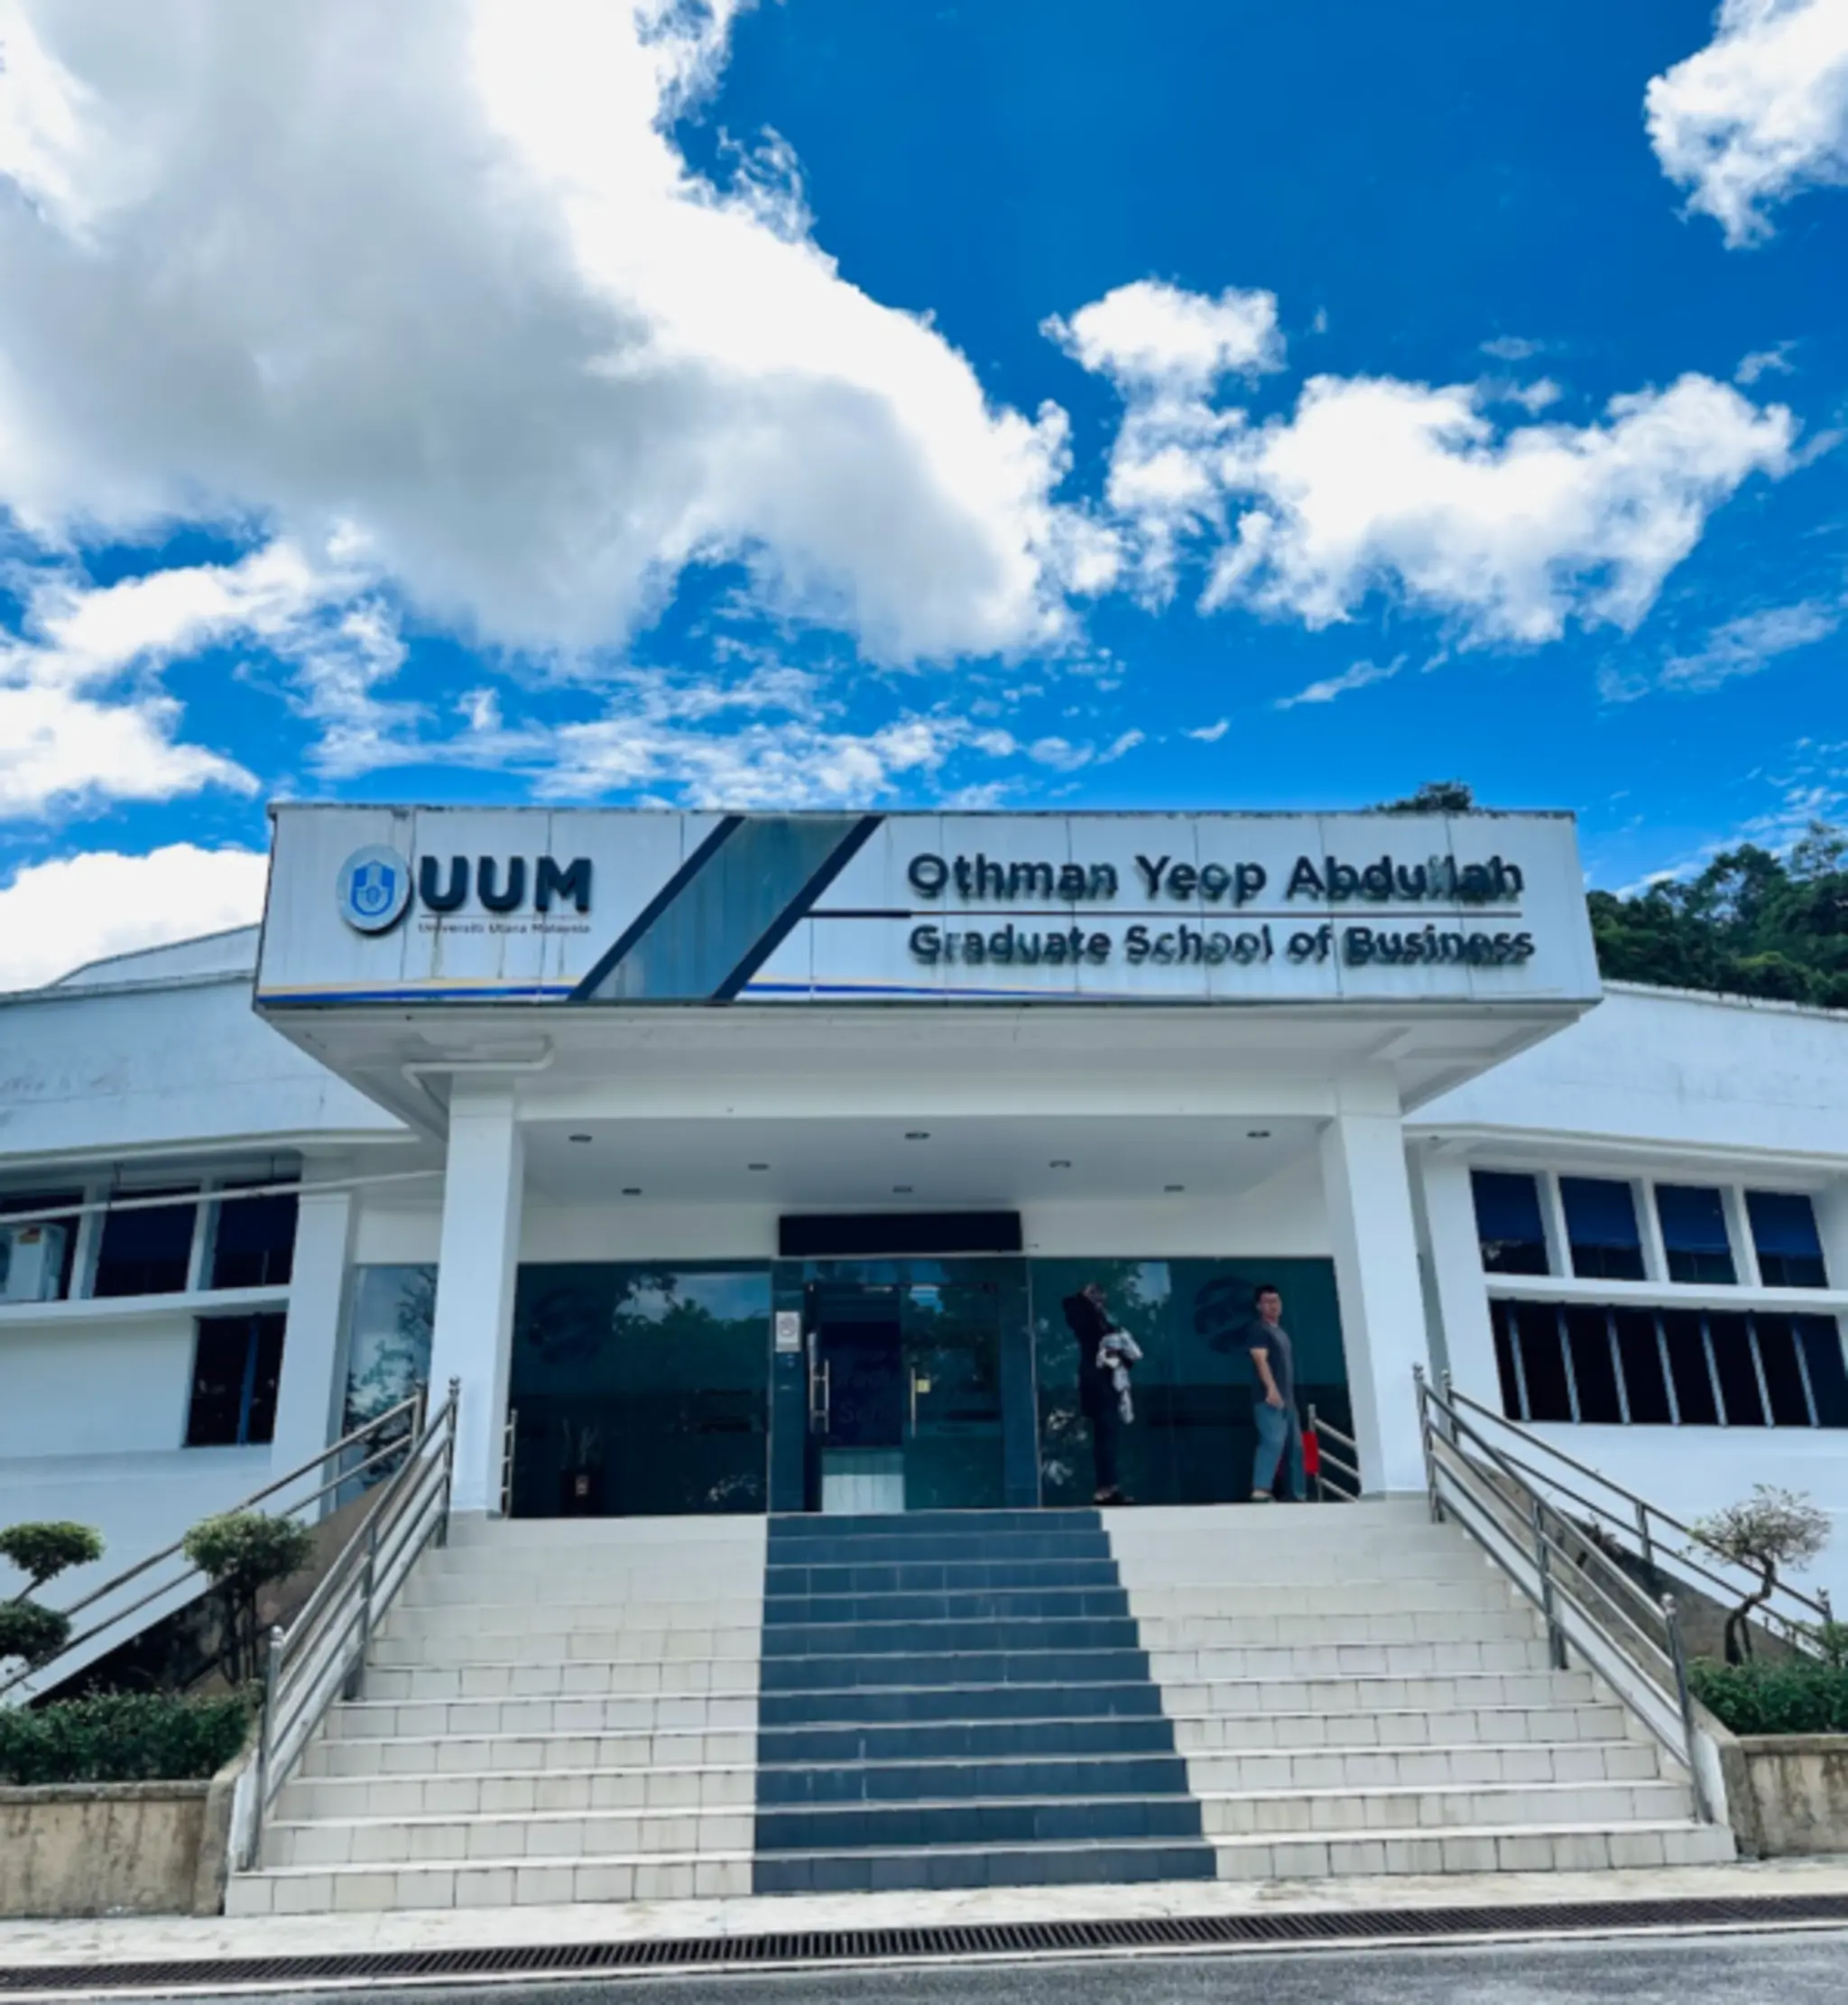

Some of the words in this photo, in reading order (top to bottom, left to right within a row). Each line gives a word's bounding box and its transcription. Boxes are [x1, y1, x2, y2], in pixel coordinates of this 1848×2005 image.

[419, 855, 592, 913] UUM
[908, 853, 1117, 900] Othman
[1135, 855, 1267, 906] Yeop
[1287, 855, 1524, 901] Abdullah
[909, 923, 1112, 964] Graduate
[1124, 924, 1274, 965] School
[1287, 925, 1332, 964] of
[1344, 925, 1536, 966] Business
